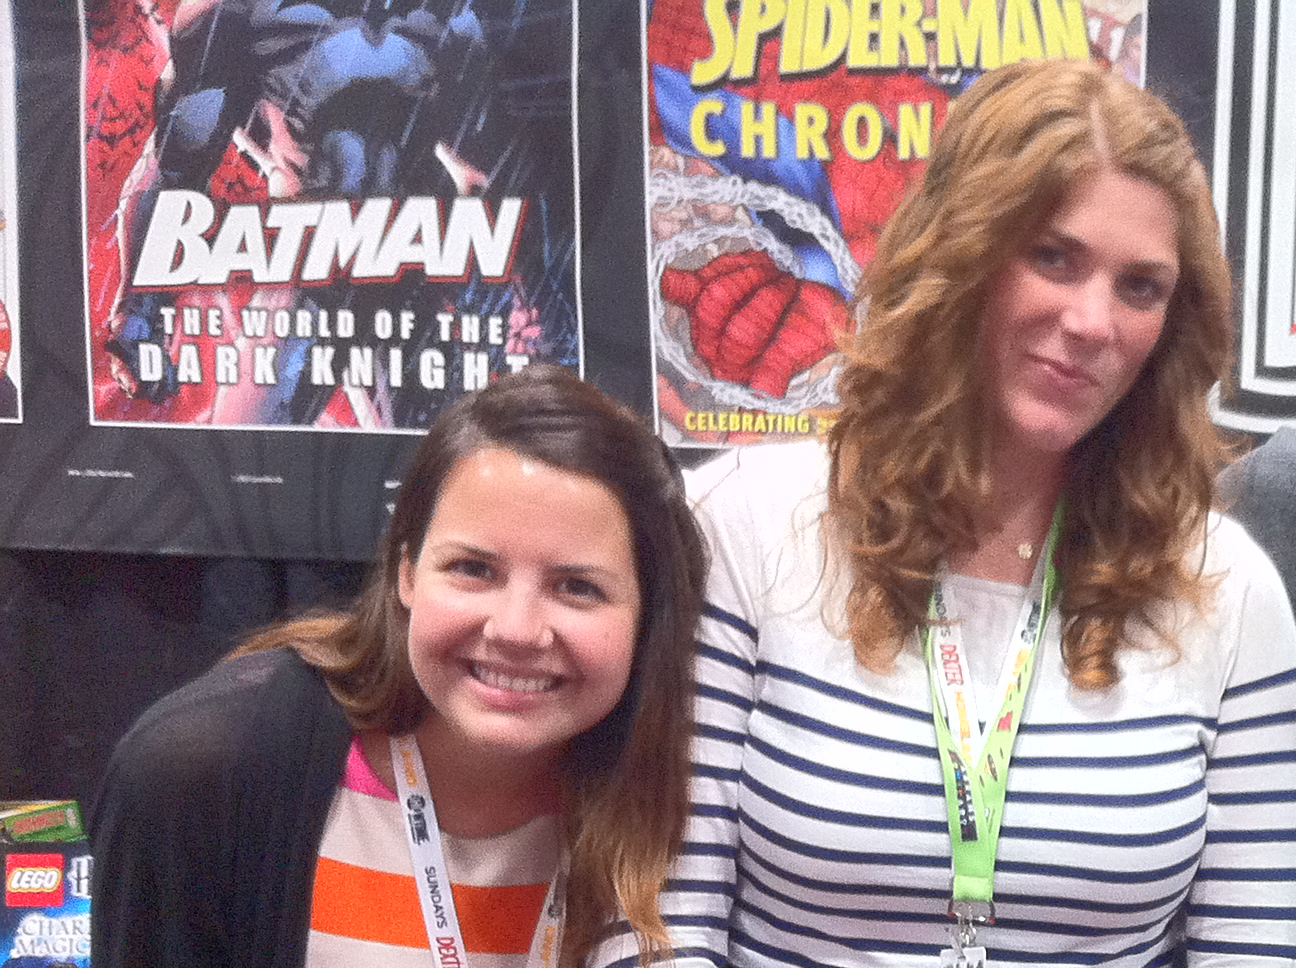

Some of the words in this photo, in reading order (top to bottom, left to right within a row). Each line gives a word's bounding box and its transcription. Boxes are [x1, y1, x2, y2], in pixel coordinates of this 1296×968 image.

[691, 0, 1090, 87] SPIDER-MAN
[132, 190, 522, 287] BATMAN
[160, 307, 222, 335] THE
[241, 309, 355, 339] WORLD
[375, 309, 416, 340] OF
[437, 313, 504, 344] THE
[138, 342, 277, 385] DARK
[311, 346, 530, 391] KNIGHT
[685, 410, 810, 433] CELEBRATING
[10, 870, 58, 889] LEGO
[424, 866, 448, 929] SUNDAYS
